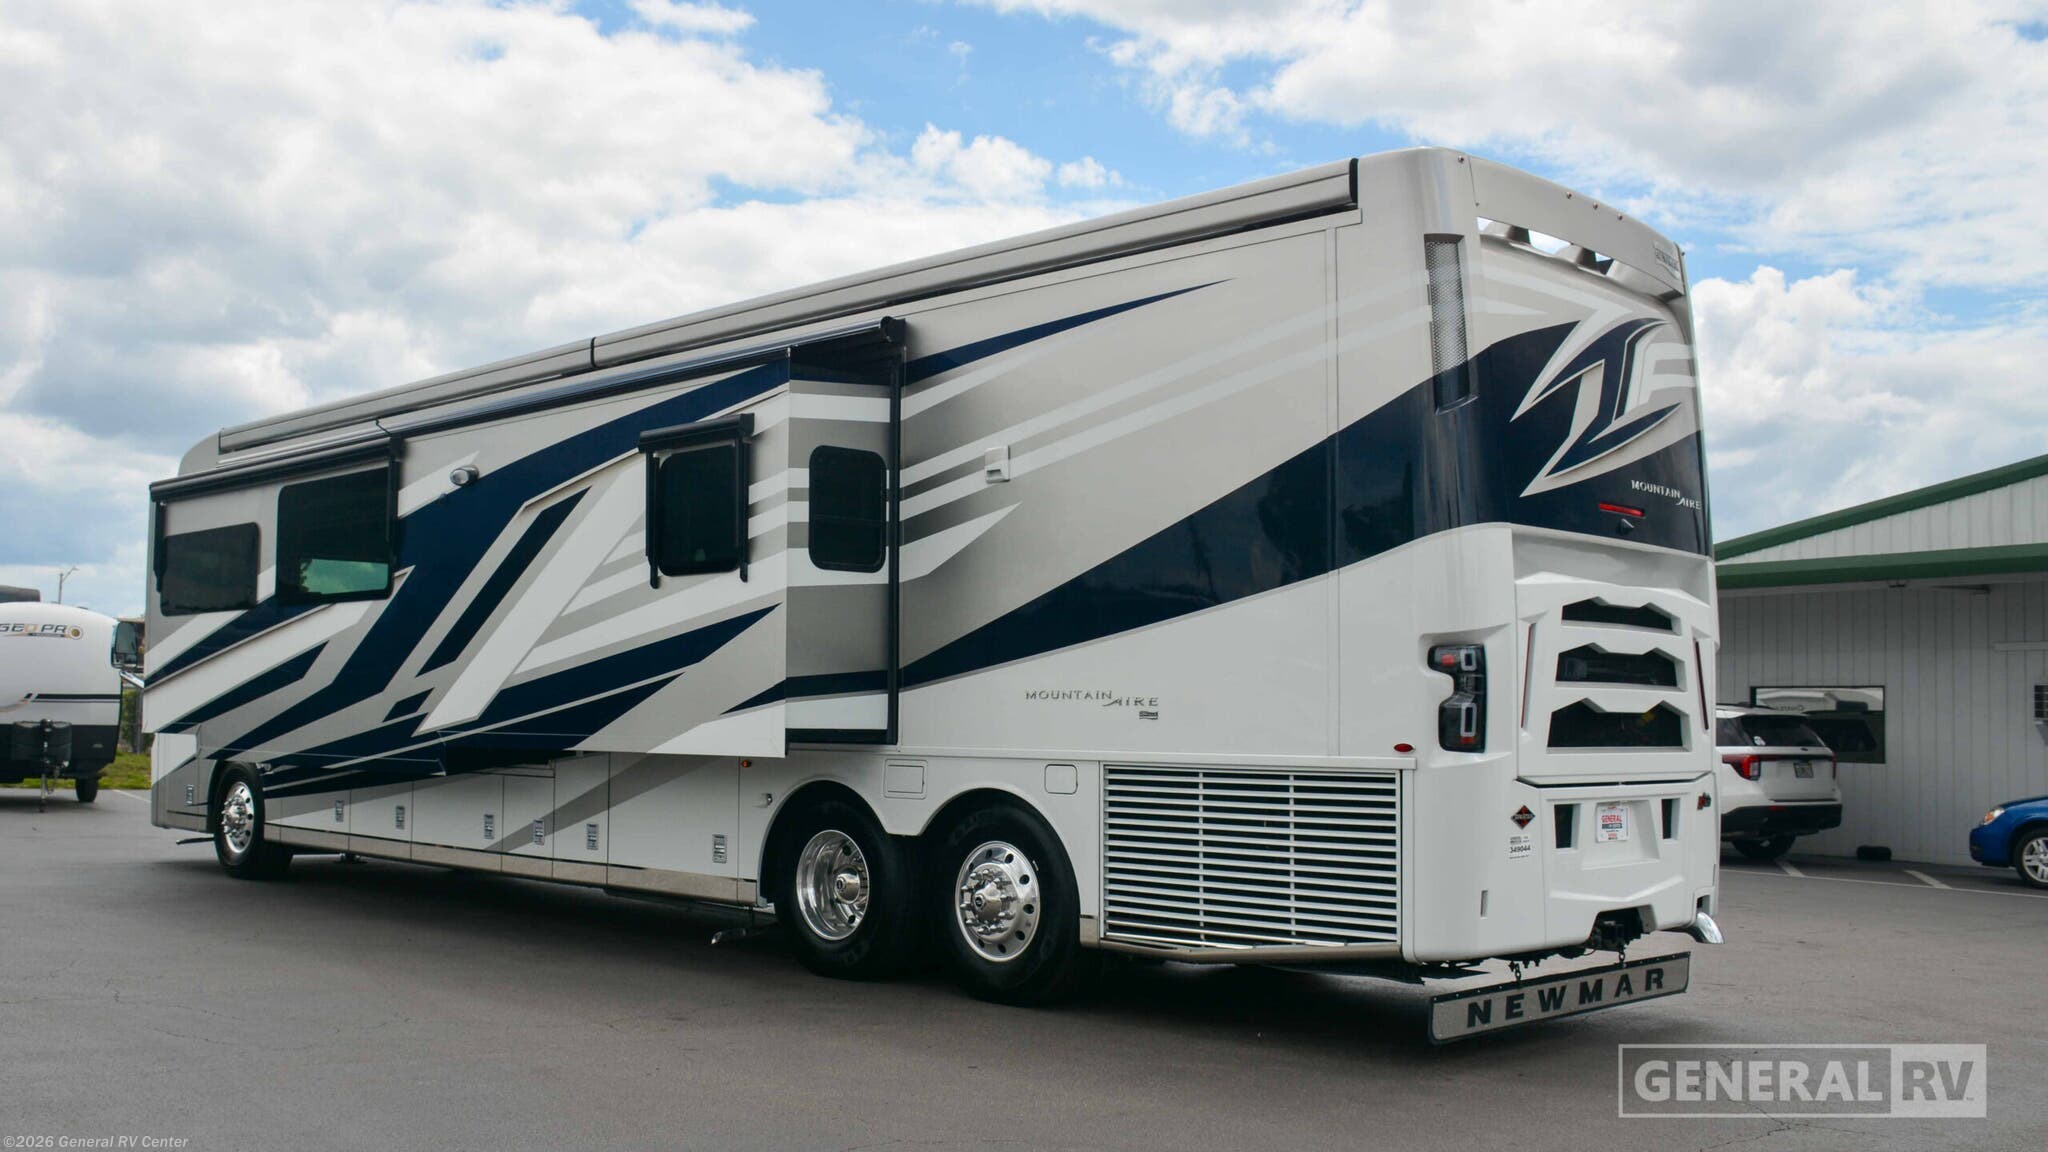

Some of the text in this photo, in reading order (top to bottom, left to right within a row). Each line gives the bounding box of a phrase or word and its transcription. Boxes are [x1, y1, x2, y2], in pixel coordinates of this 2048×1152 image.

[1631, 480, 1701, 510] MOUNTAIN AIRE
[1026, 690, 1159, 707] MOUNTAIN AIRE
[1467, 968, 1664, 1028] NEWMAR
